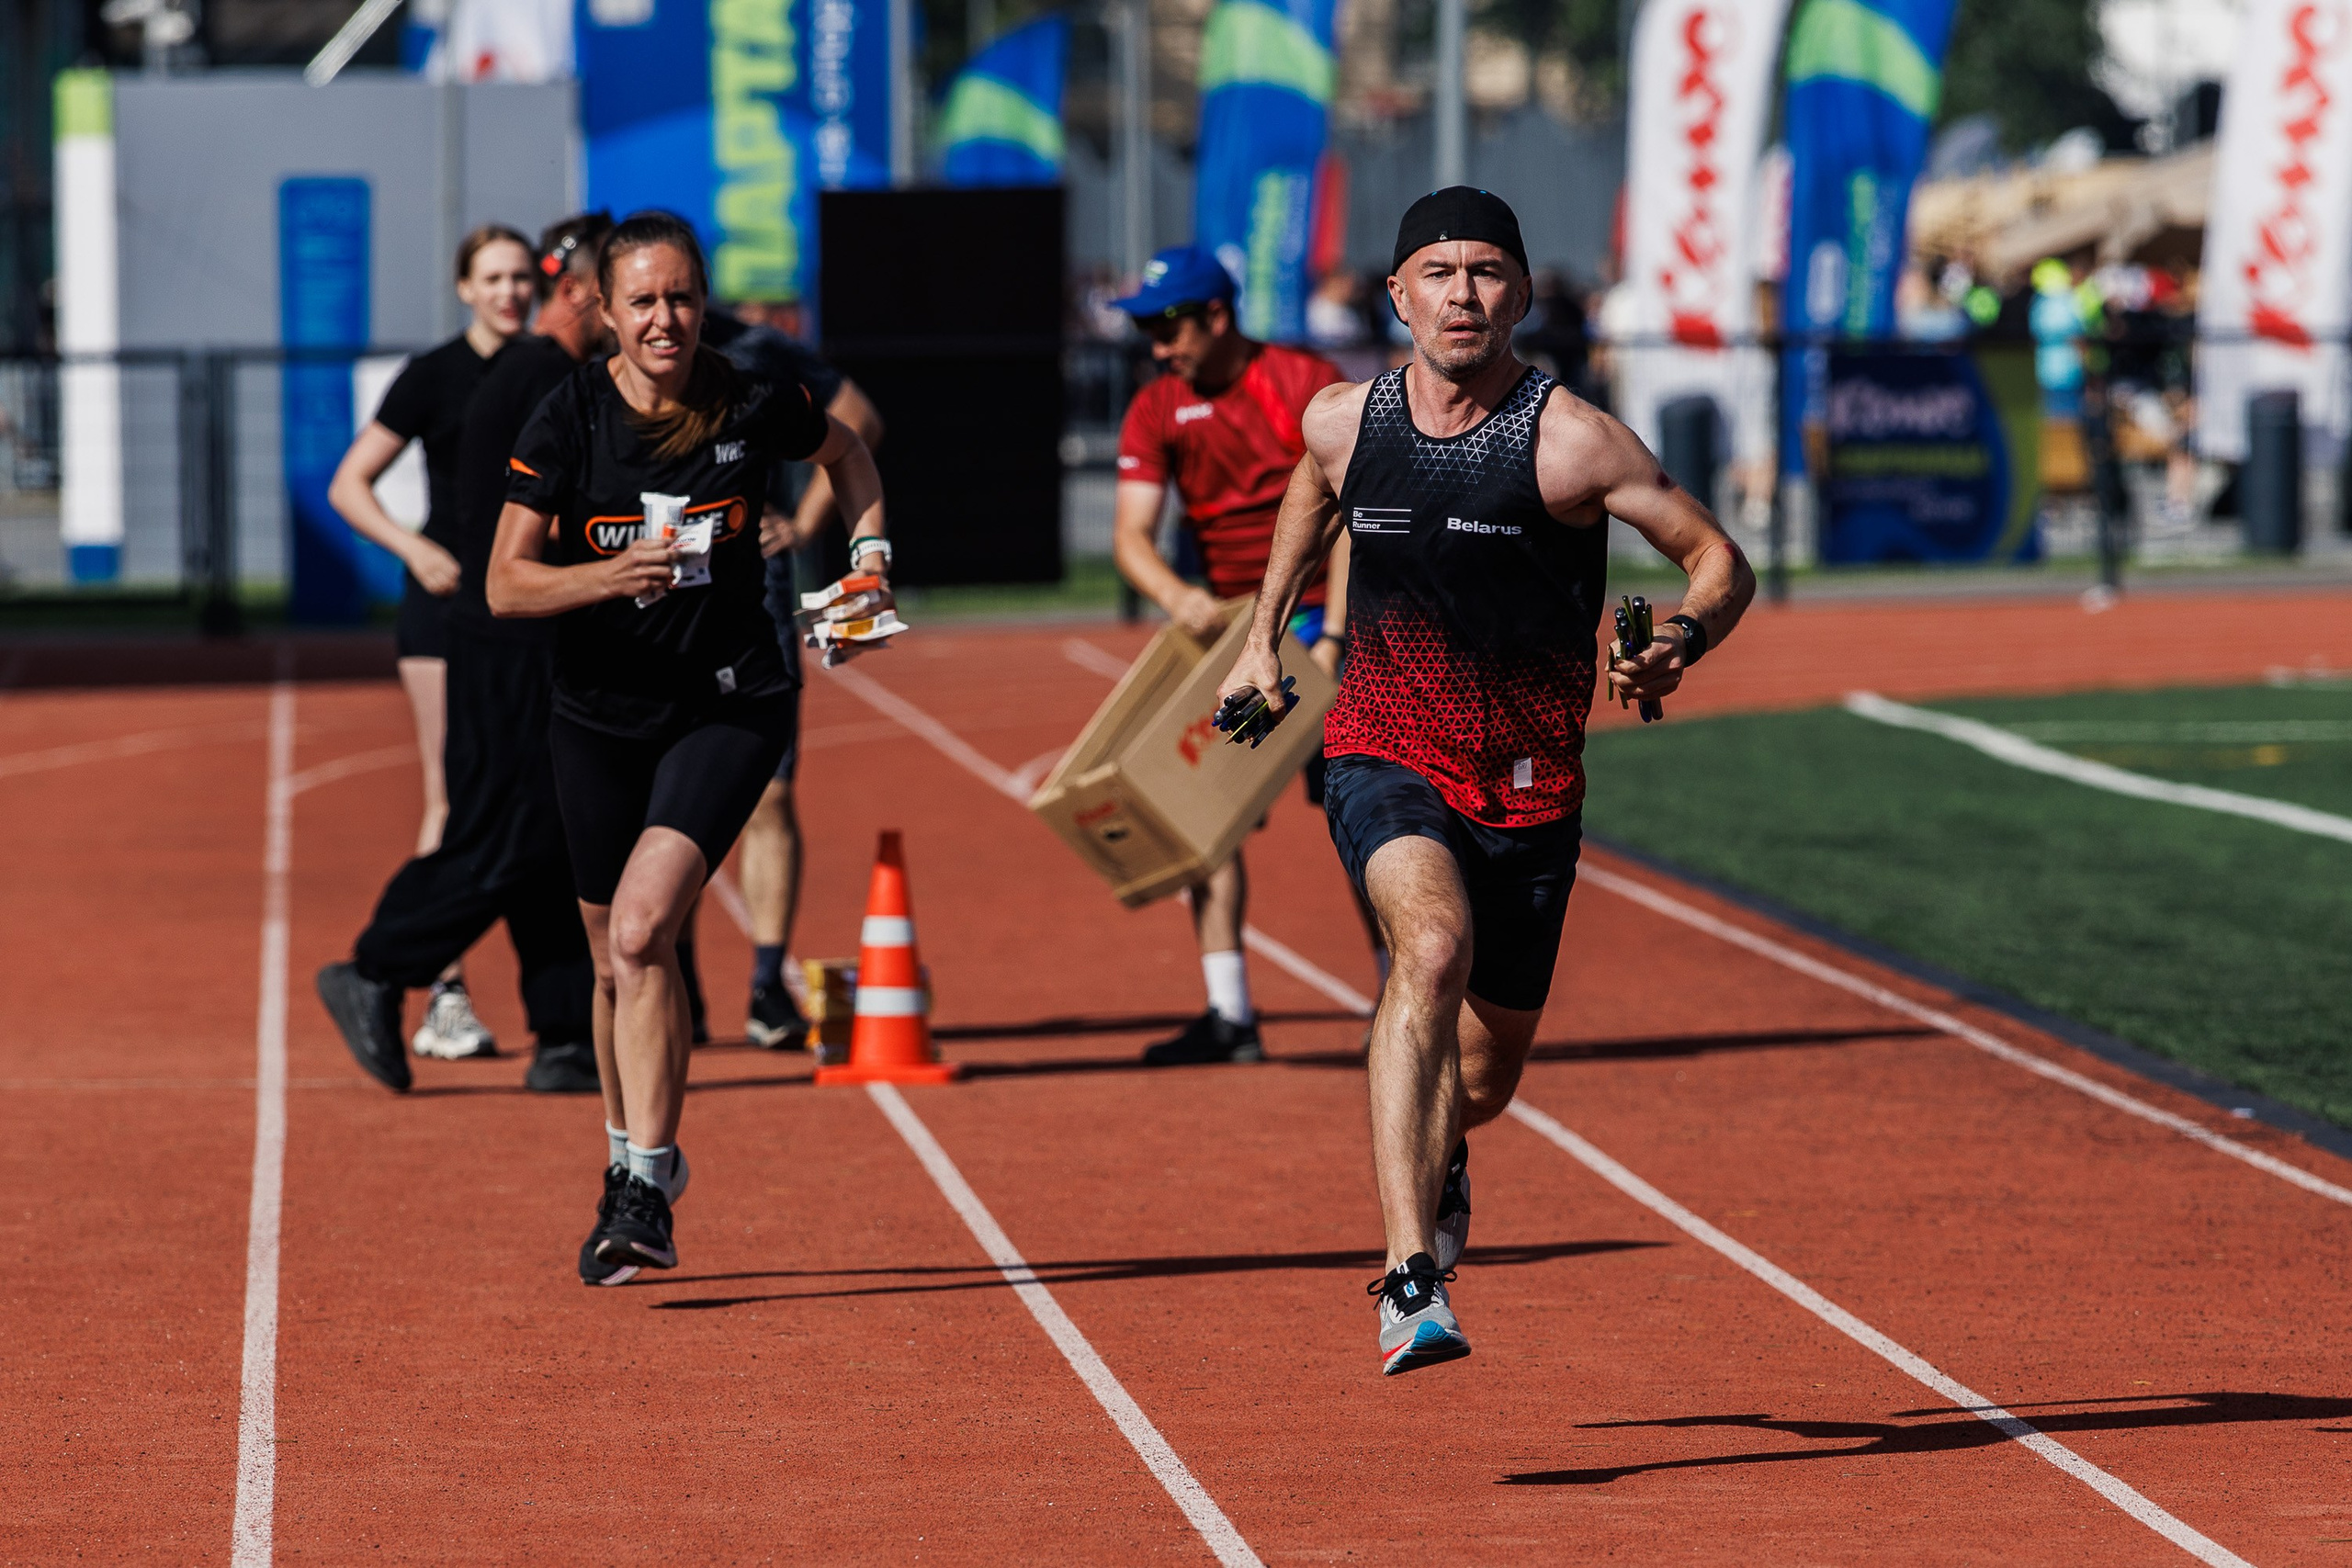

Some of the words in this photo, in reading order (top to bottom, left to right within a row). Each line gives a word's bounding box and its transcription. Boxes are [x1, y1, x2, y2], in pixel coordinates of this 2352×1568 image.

[1352, 510, 1363, 518] Be
[1352, 521, 1381, 530] Runner
[1446, 517, 1522, 536] Belarus
